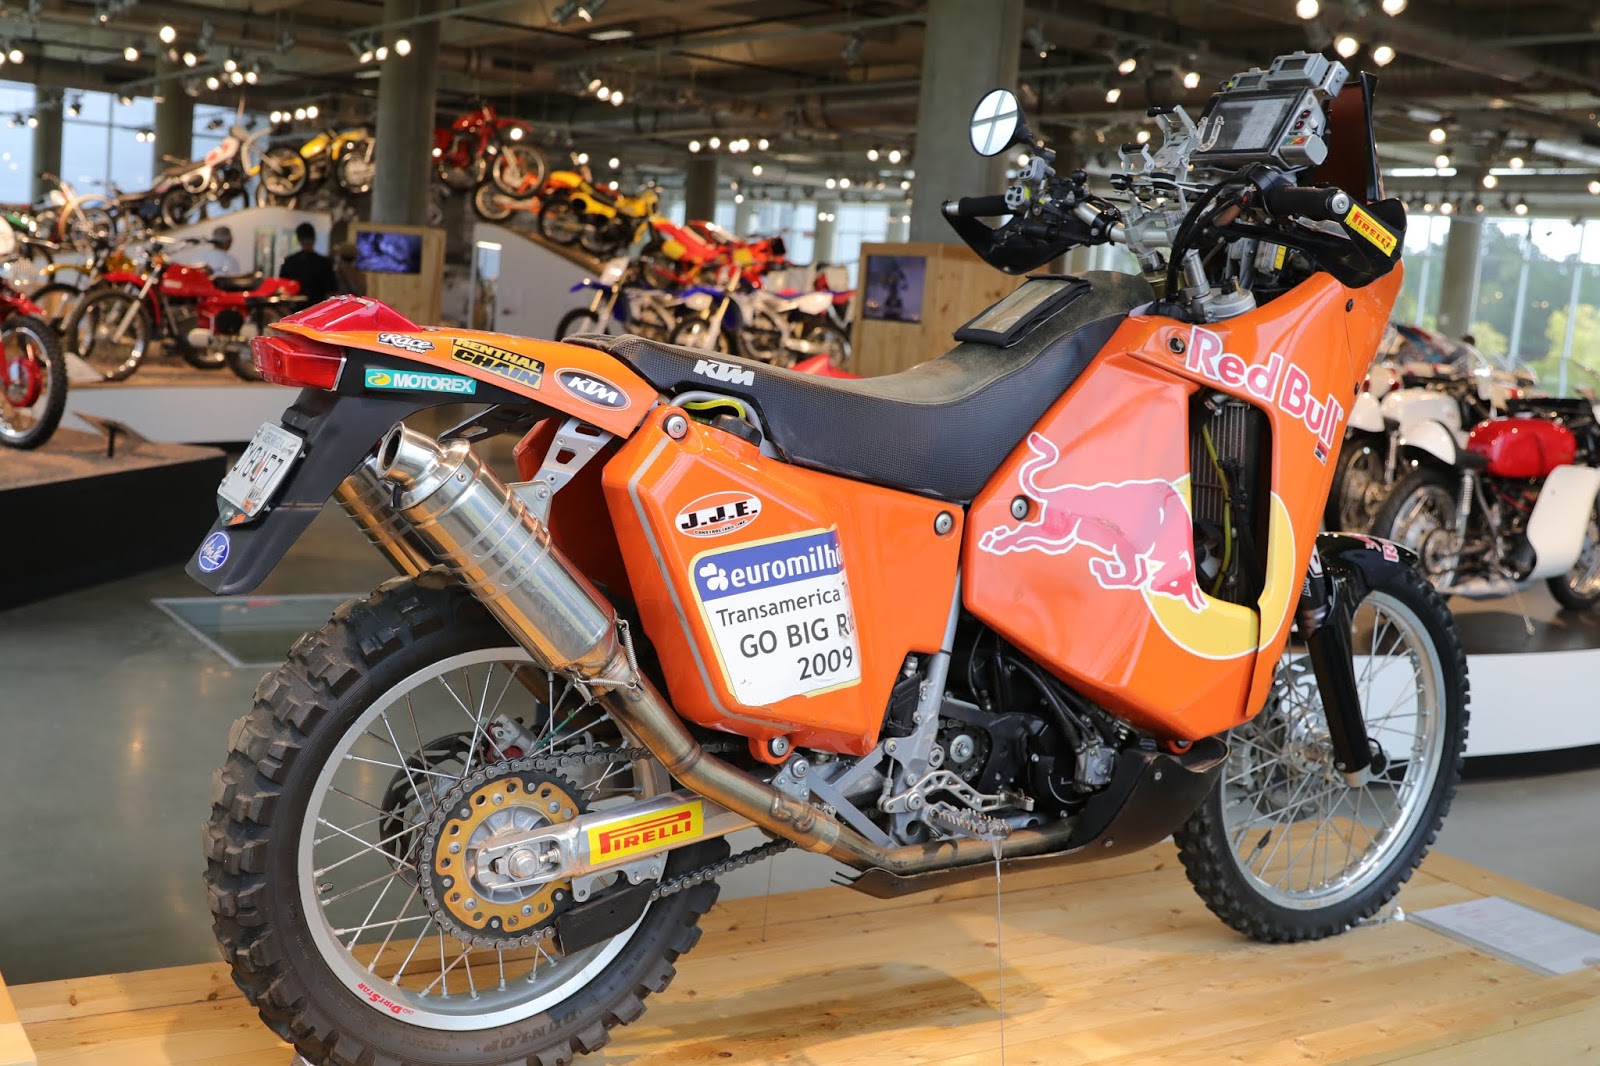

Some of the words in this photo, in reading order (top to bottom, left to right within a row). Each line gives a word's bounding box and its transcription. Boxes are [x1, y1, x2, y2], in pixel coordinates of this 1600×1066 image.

[1352, 211, 1393, 249] PIRELLI
[379, 333, 435, 350] Race
[454, 338, 543, 372] RENTHAL
[393, 373, 474, 393] MOTOREX
[453, 349, 541, 388] CHAIN
[693, 360, 755, 386] KTM
[567, 377, 618, 404] KTM
[1186, 325, 1283, 402] Red
[1278, 363, 1340, 449] Bull
[681, 501, 758, 530] J.J.E.
[716, 588, 841, 627] Transamerica
[740, 630, 778, 659] GO
[786, 618, 829, 648] BIG
[797, 646, 853, 680] 2009
[599, 811, 692, 854] PIRELLI
